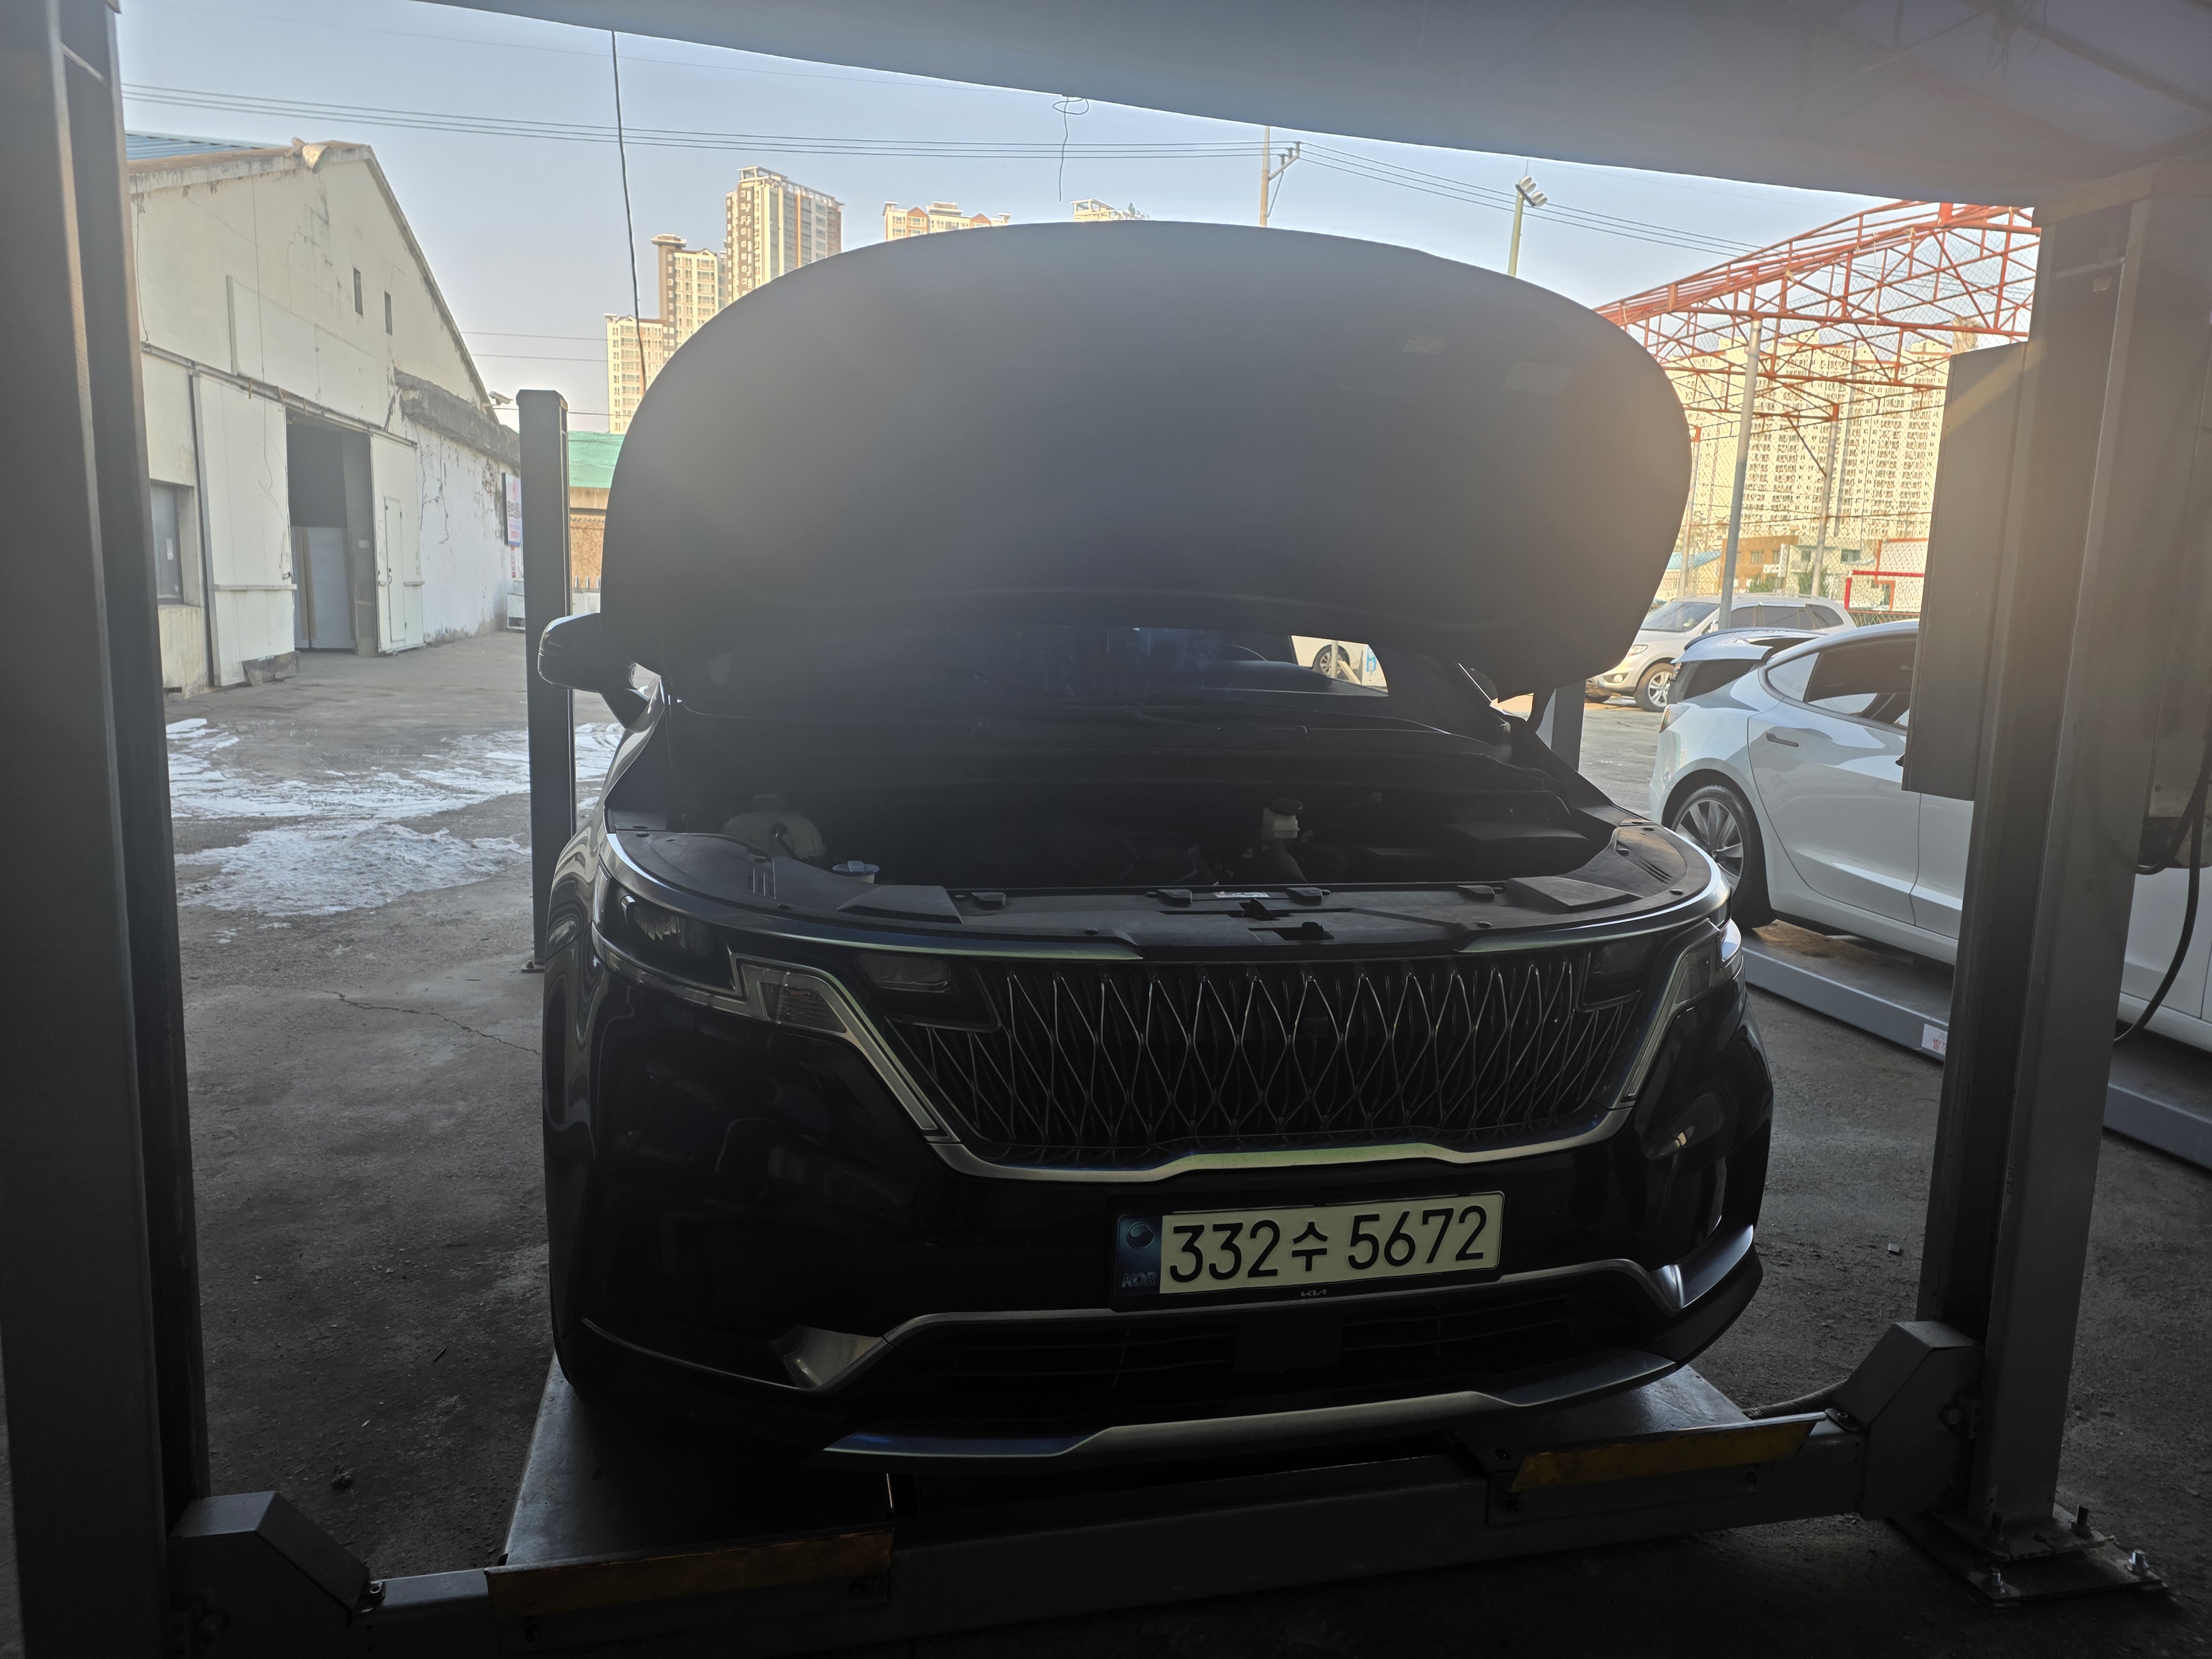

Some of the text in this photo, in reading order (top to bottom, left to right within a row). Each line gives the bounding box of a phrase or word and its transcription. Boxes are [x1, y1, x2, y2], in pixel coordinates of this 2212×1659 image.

[1169, 1206, 1488, 1282] 332수 5672
[1121, 1271, 1156, 1288] KOR
